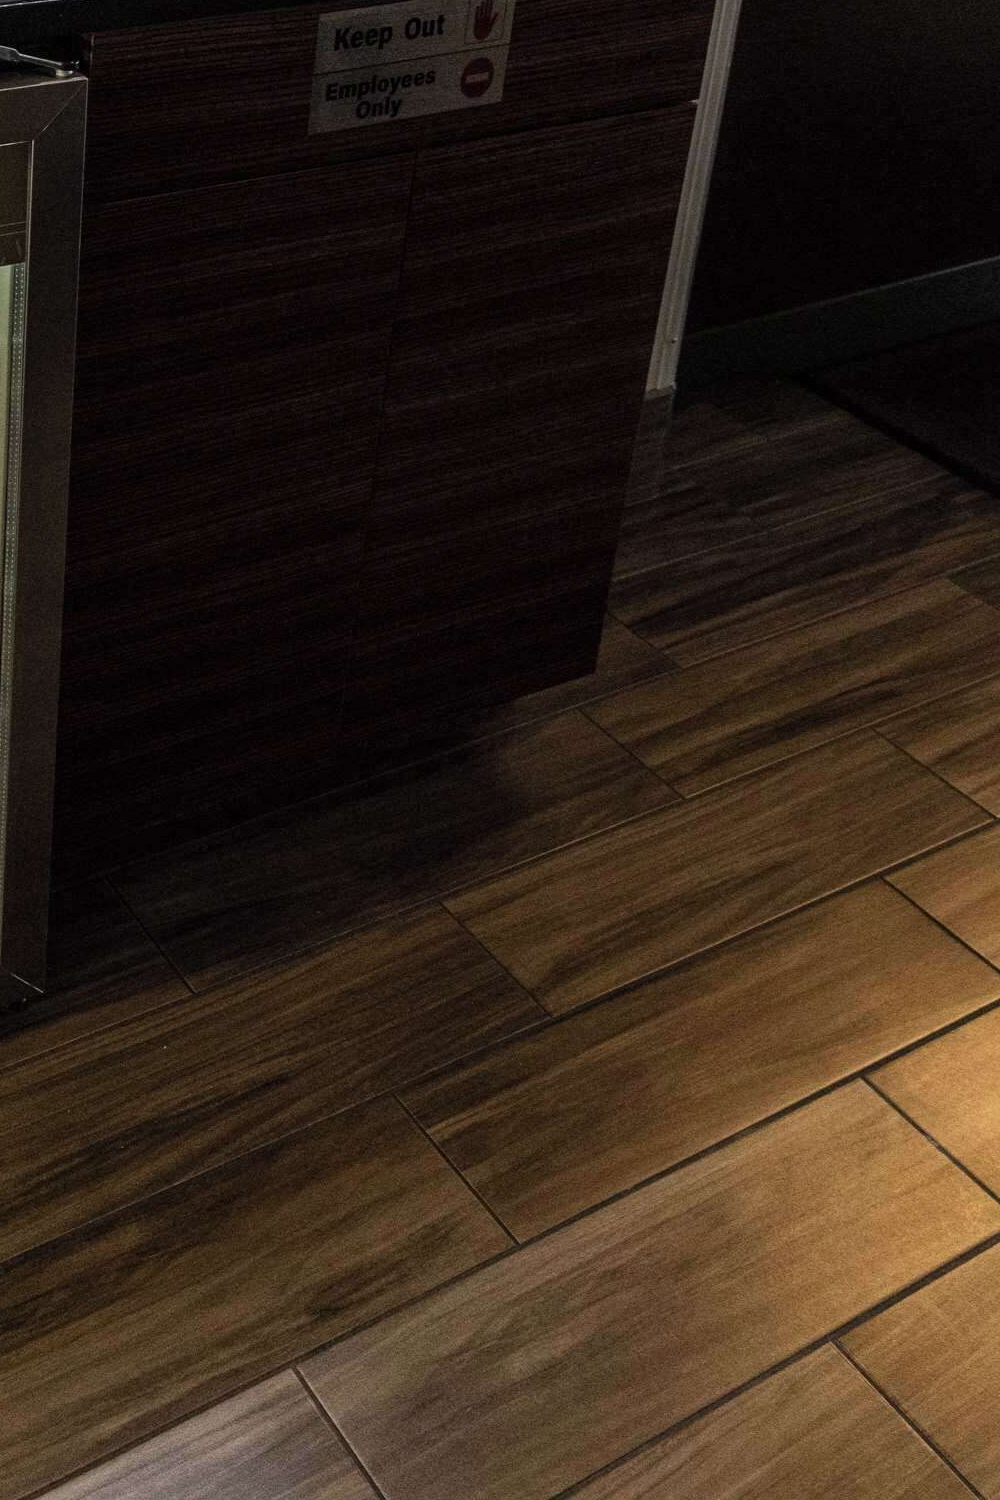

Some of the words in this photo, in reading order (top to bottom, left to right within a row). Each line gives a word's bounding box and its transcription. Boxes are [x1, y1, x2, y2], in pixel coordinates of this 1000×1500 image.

[334, 25, 393, 51] Keep
[404, 14, 446, 40] Out
[325, 69, 437, 102] Employees
[355, 96, 403, 120] Only
